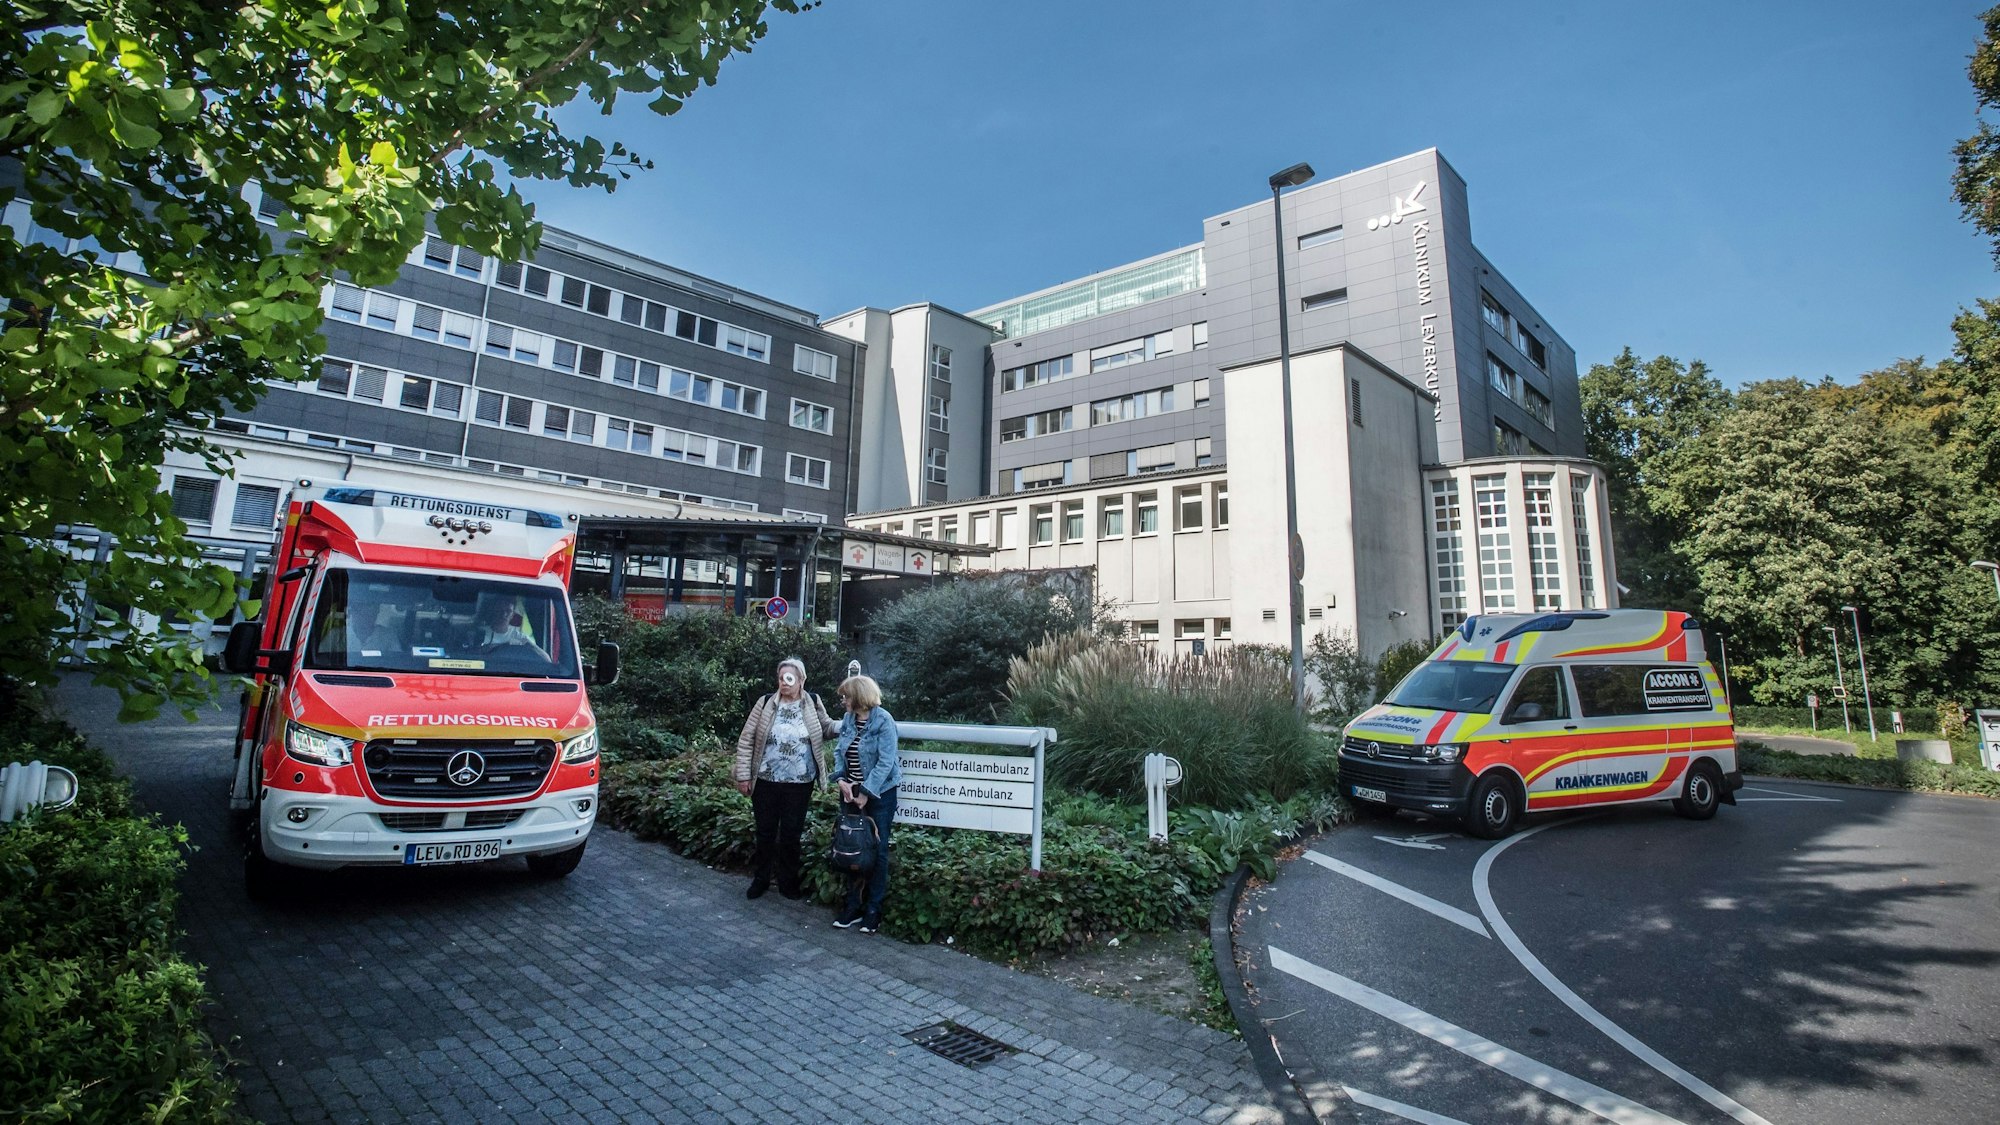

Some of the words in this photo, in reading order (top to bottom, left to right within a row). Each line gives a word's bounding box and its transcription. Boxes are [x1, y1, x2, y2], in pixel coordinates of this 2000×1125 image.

[1413, 219, 1432, 306] KLINIKUM
[390, 495, 513, 520] RETTUNGSDIENST
[877, 548, 901, 558] Wagen-
[877, 558, 892, 567] halle
[1650, 673, 1689, 688] ACCON
[1648, 694, 1707, 705] KRANKENTRANSPORT
[368, 714, 558, 728] RETTUNGSDIENST
[941, 759, 1030, 775] Notfallambulanz
[1555, 770, 1648, 789] KRANKENWAGEN
[959, 786, 1013, 800] Ambulanz
[416, 846, 444, 860] LEV
[453, 845, 471, 859] RD
[474, 843, 498, 857] 896
